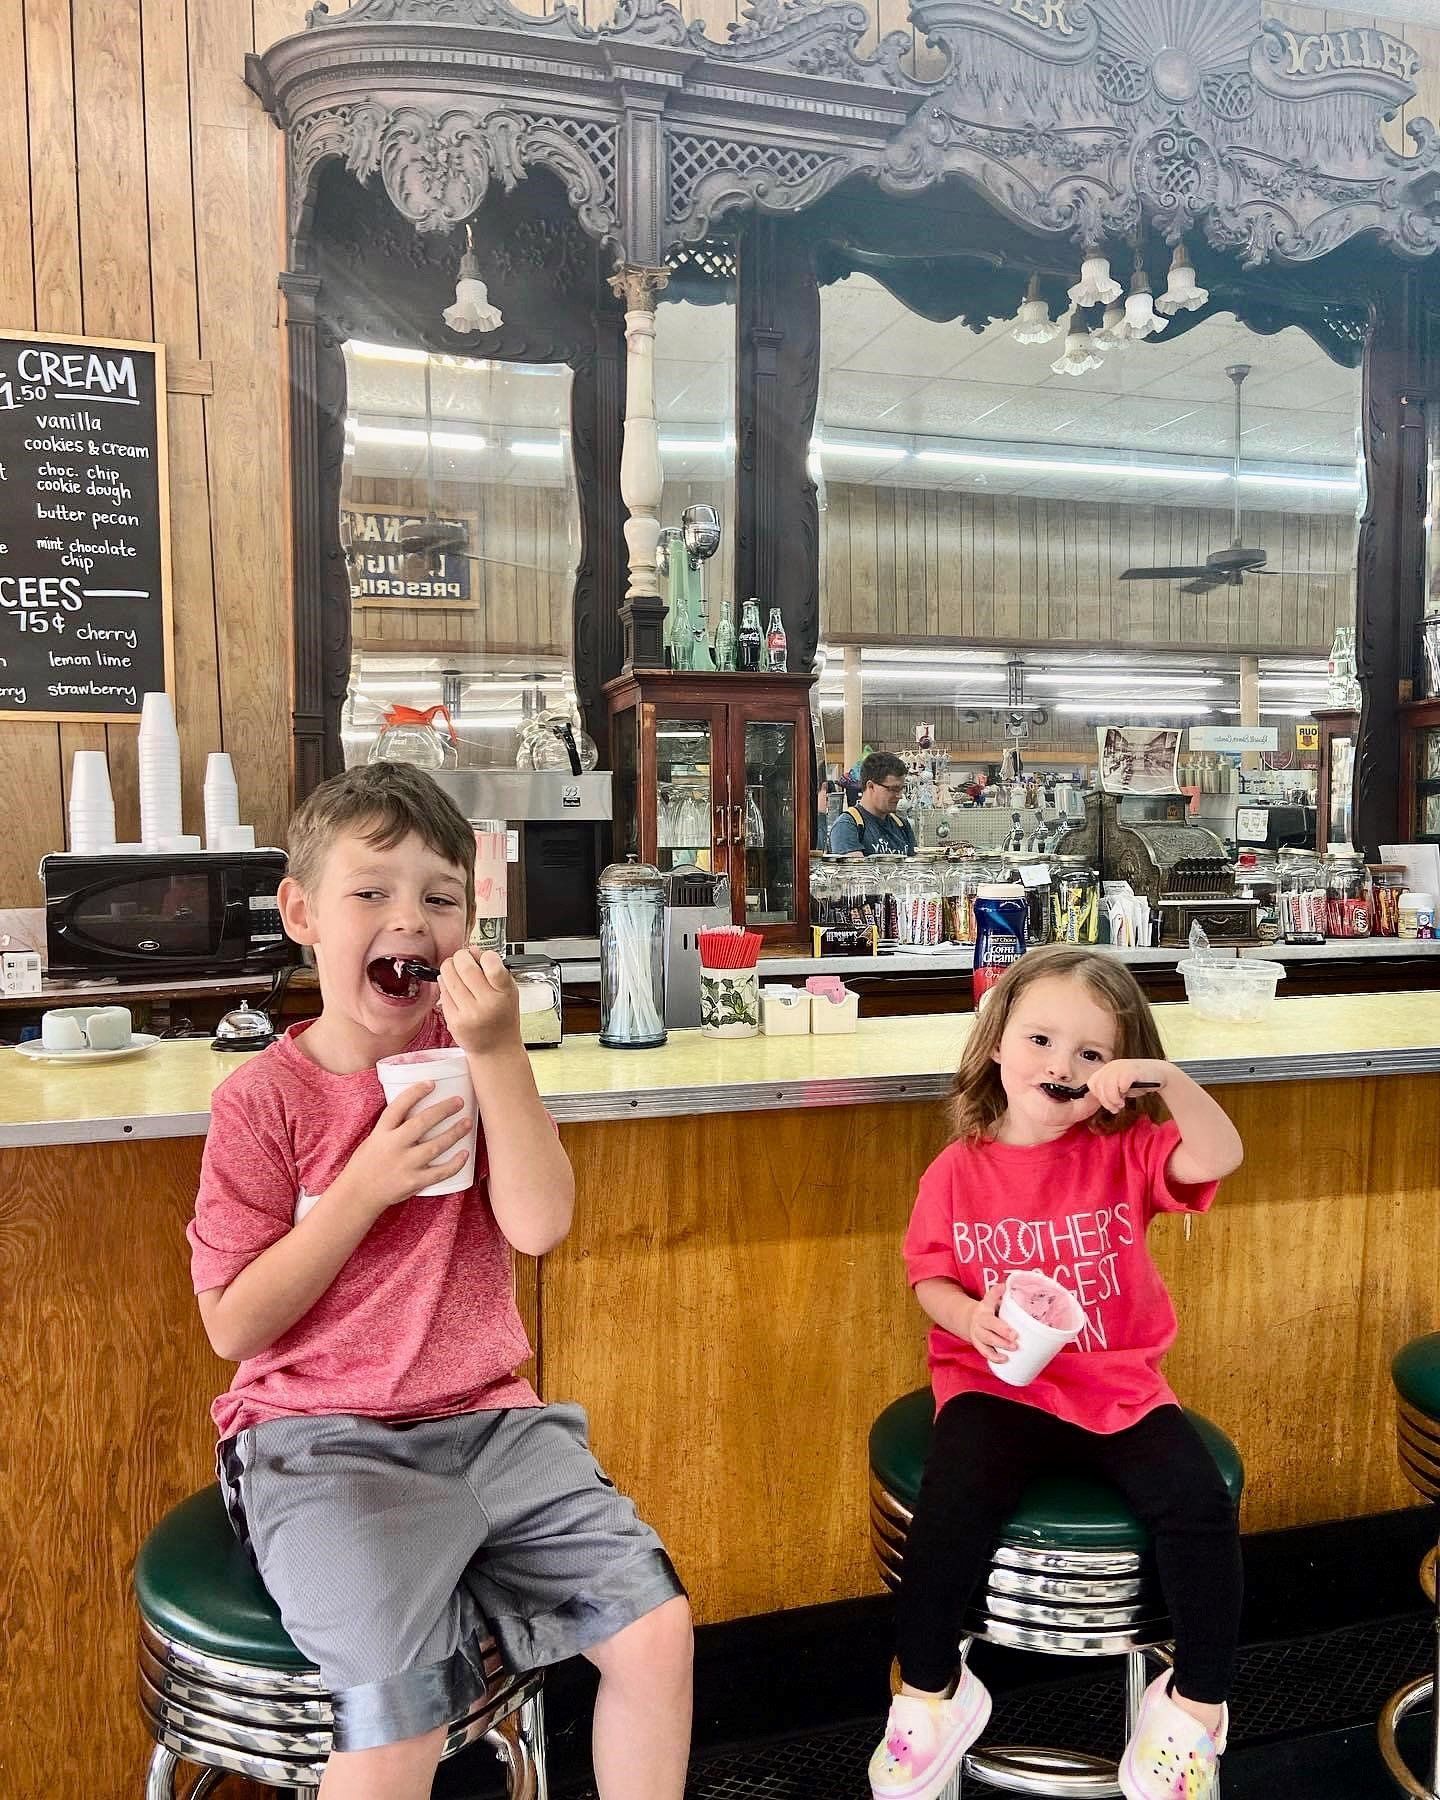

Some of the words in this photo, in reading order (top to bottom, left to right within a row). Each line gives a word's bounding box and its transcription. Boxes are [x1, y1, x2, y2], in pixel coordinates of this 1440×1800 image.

[1283, 31, 1419, 82] VALLEY
[18, 349, 137, 398] CREAM
[36, 411, 102, 431] vanilla
[24, 436, 84, 452] cookies
[88, 440, 100, 456] &
[102, 442, 149, 458] cream
[38, 461, 79, 477] choc.
[87, 464, 120, 485] chip
[37, 477, 81, 493] cookie
[86, 481, 131, 506] dough
[37, 502, 86, 521] butter
[92, 512, 139, 530] pecan
[36, 537, 65, 551] mint
[69, 538, 137, 557] chocolate
[61, 551, 94, 575] chip
[0, 577, 82, 611] CEES
[76, 622, 138, 649] cherry
[48, 650, 92, 667] lemon
[96, 650, 132, 667] lime
[48, 680, 137, 705] strawberry
[953, 1203, 1135, 1265] BROTHER'S
